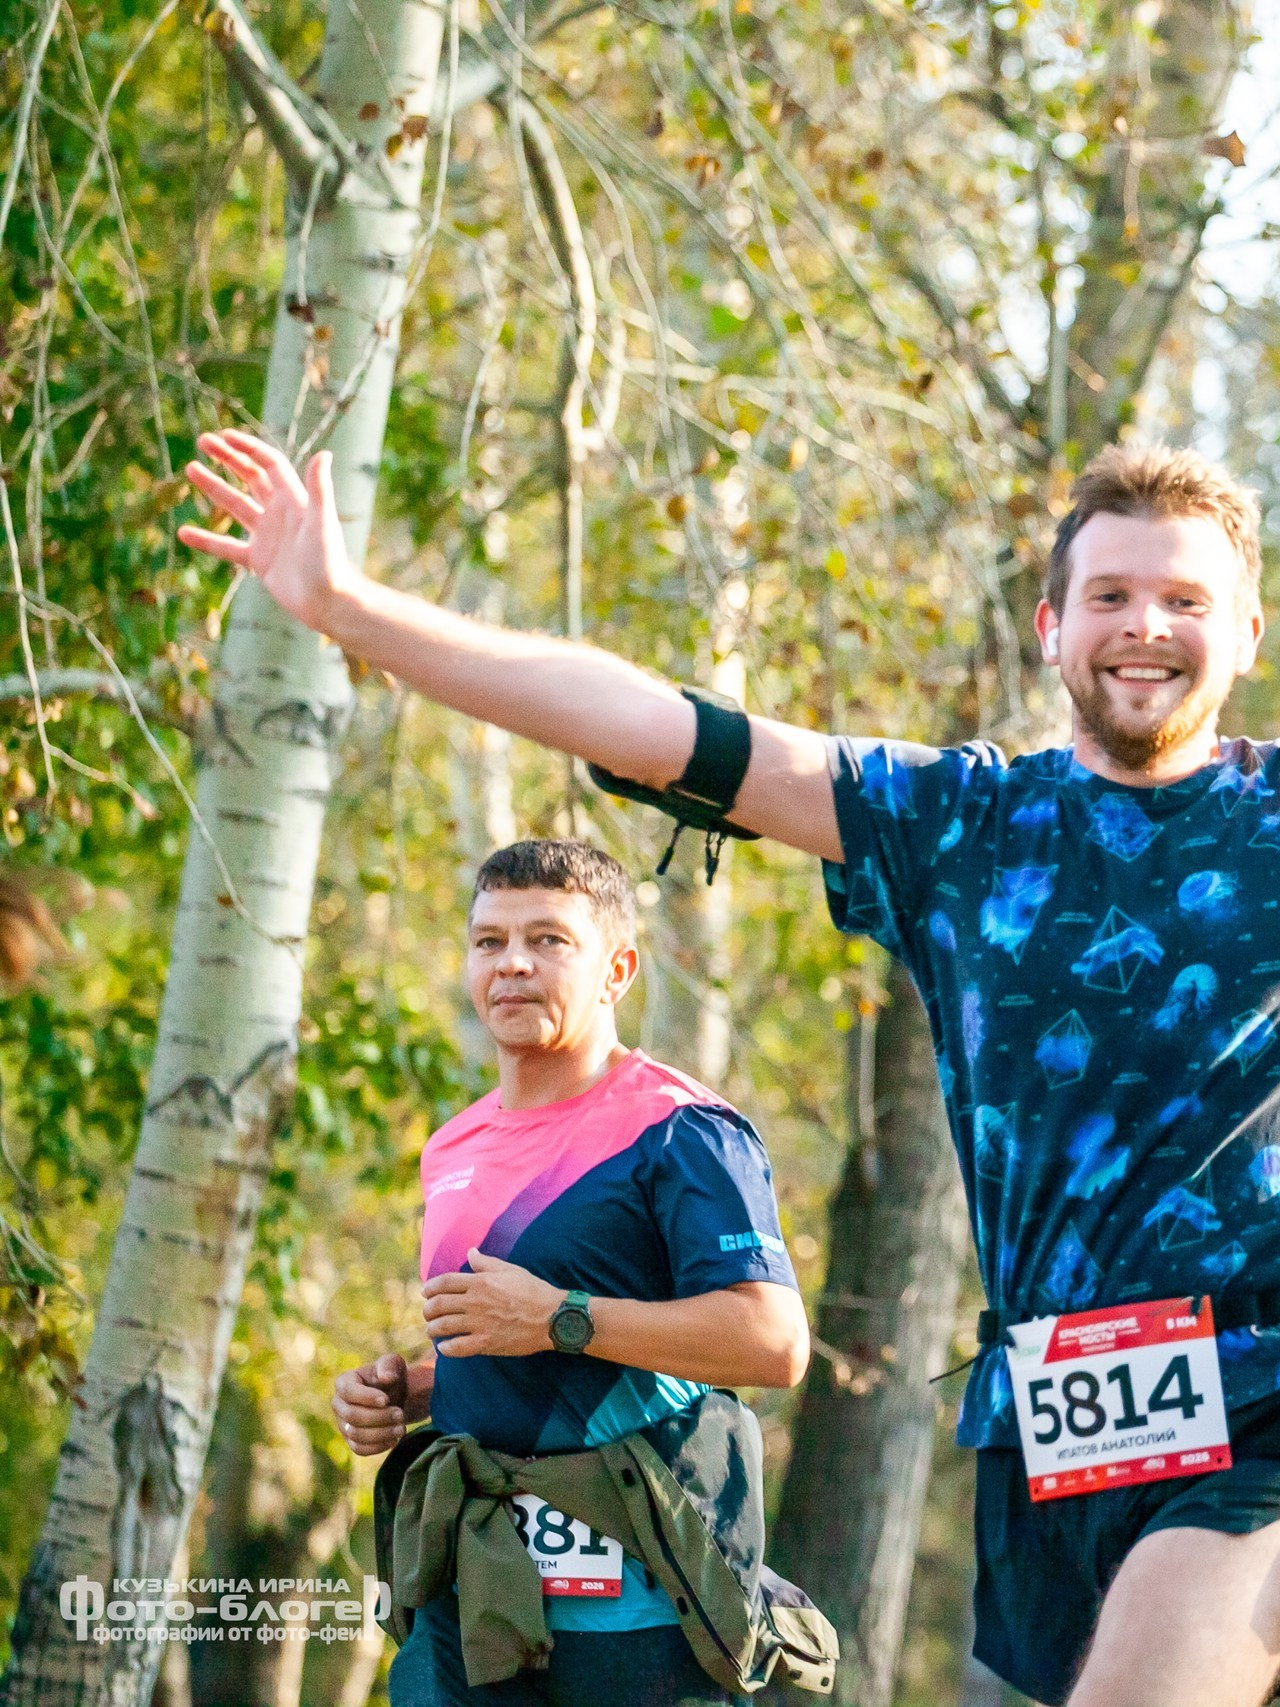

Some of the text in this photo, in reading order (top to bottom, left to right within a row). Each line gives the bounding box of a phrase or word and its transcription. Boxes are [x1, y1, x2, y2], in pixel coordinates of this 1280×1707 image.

[1028, 1354, 1204, 1445] 5814
[1057, 1427, 1176, 1460] ИПАТОВ АНАТОЛИЙ
